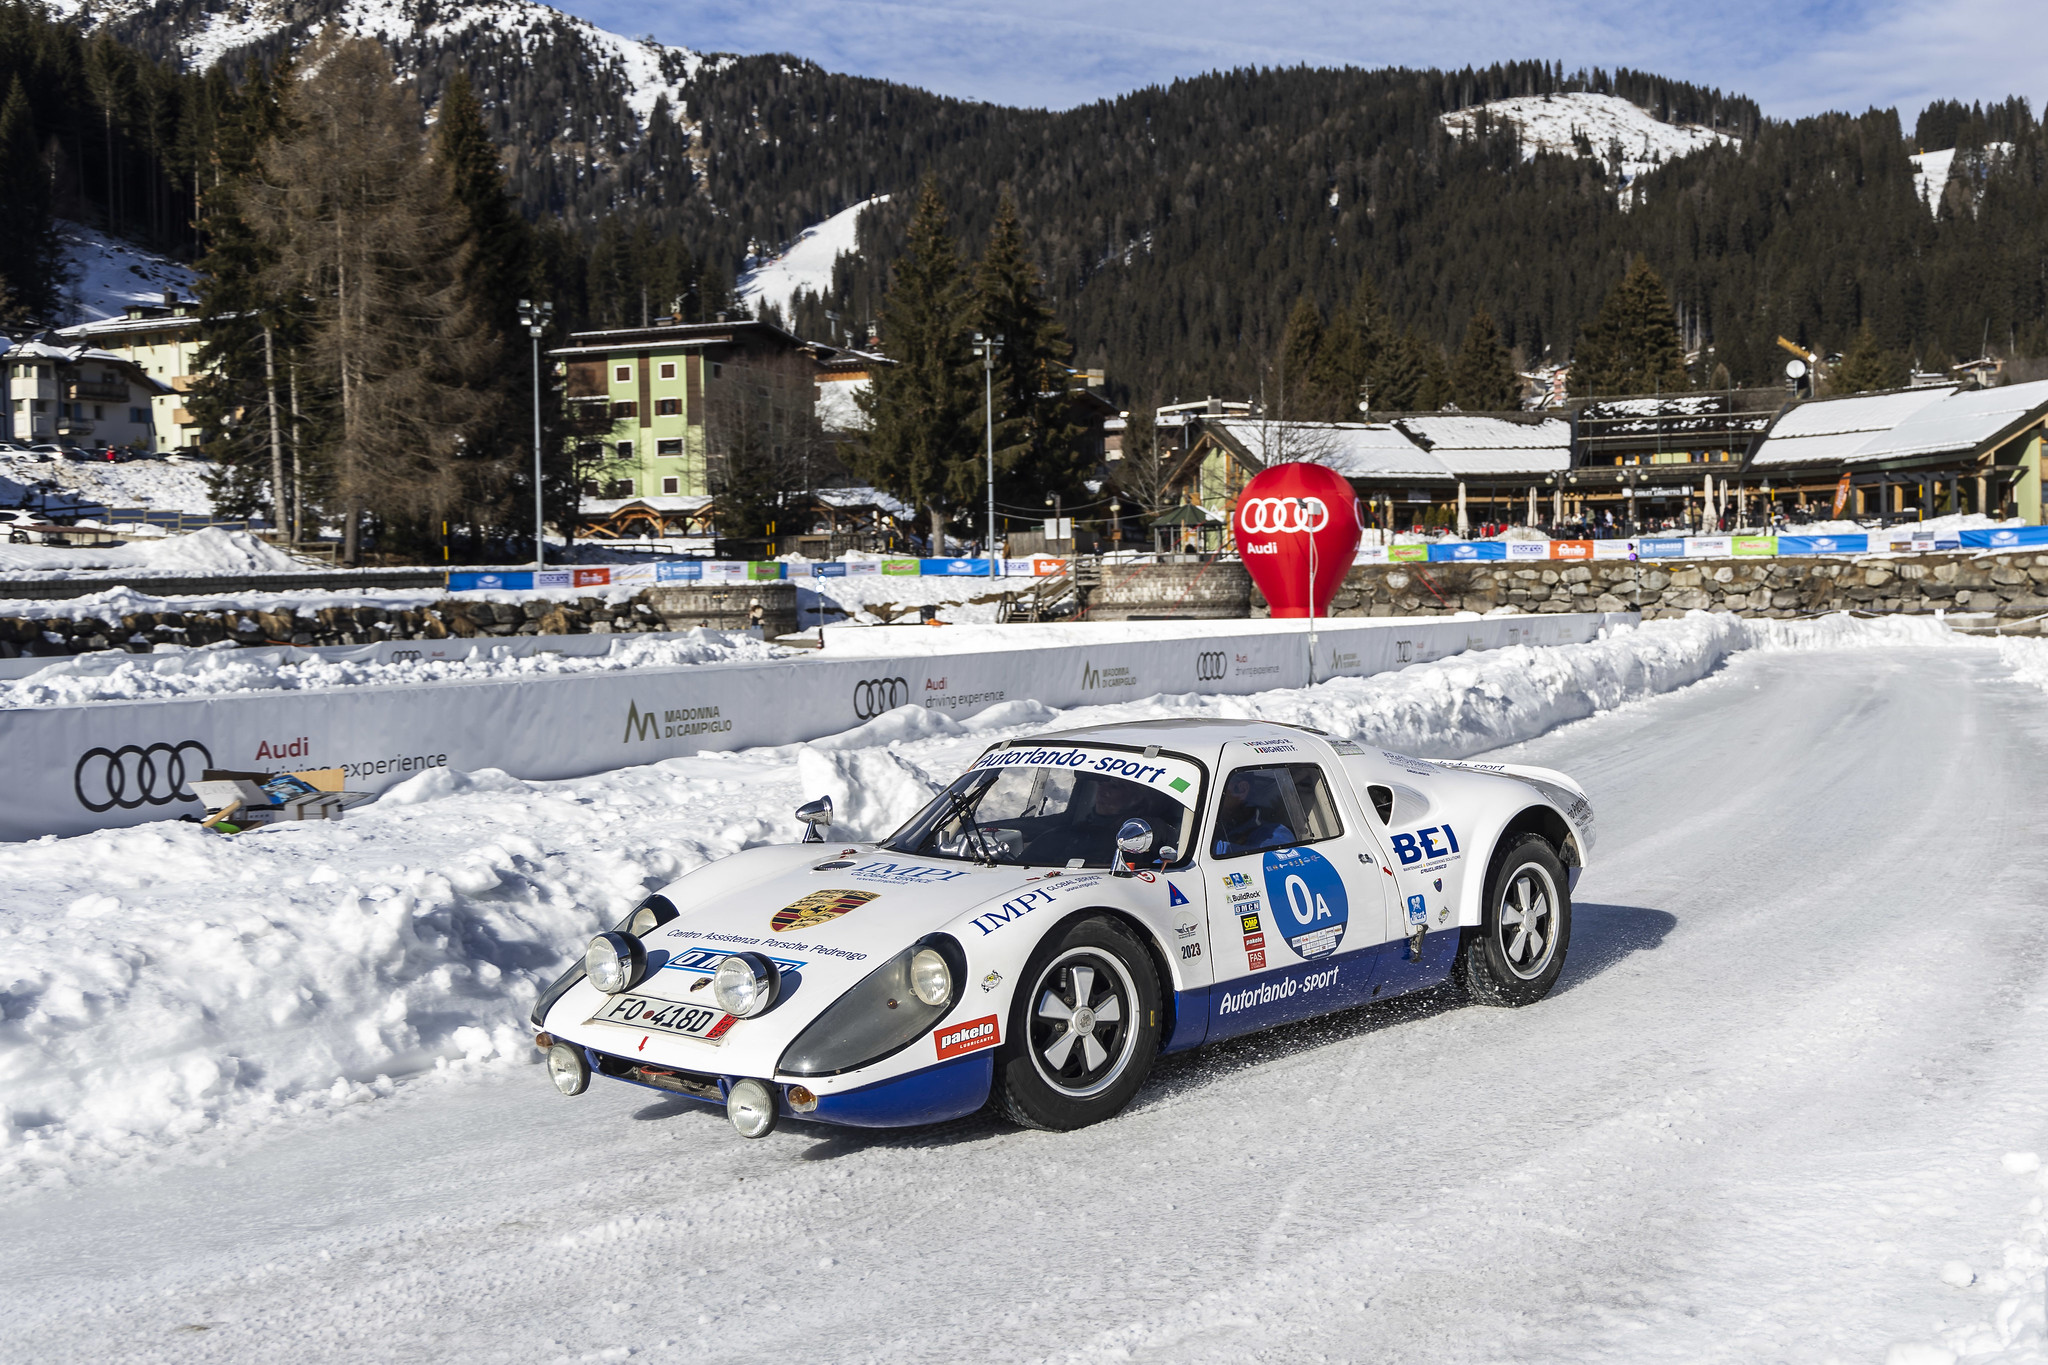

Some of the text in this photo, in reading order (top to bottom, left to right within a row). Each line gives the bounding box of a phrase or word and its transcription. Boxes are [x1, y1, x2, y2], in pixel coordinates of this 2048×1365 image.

[1247, 542, 1278, 554] Audi
[1235, 653, 1248, 663] Audi
[1102, 667, 1130, 677] MADONNA
[925, 677, 948, 691] Audi
[925, 689, 1005, 708] driving experience
[664, 706, 720, 723] MADONNA
[665, 720, 732, 738] DI CAMPIGLIO
[255, 737, 309, 760] Audi
[341, 753, 448, 780] experience
[1390, 824, 1460, 865] BEI
[851, 861, 971, 882] IMPI
[968, 888, 1056, 937] IMPI
[1235, 902, 1259, 913] OMCN
[1244, 918, 1258, 928] OMP
[667, 929, 868, 961] Centro Assistenza Porsche Pedrengo
[1181, 943, 1201, 959] 2023
[608, 998, 715, 1032] FO 418D
[941, 1023, 994, 1049] pakelo
